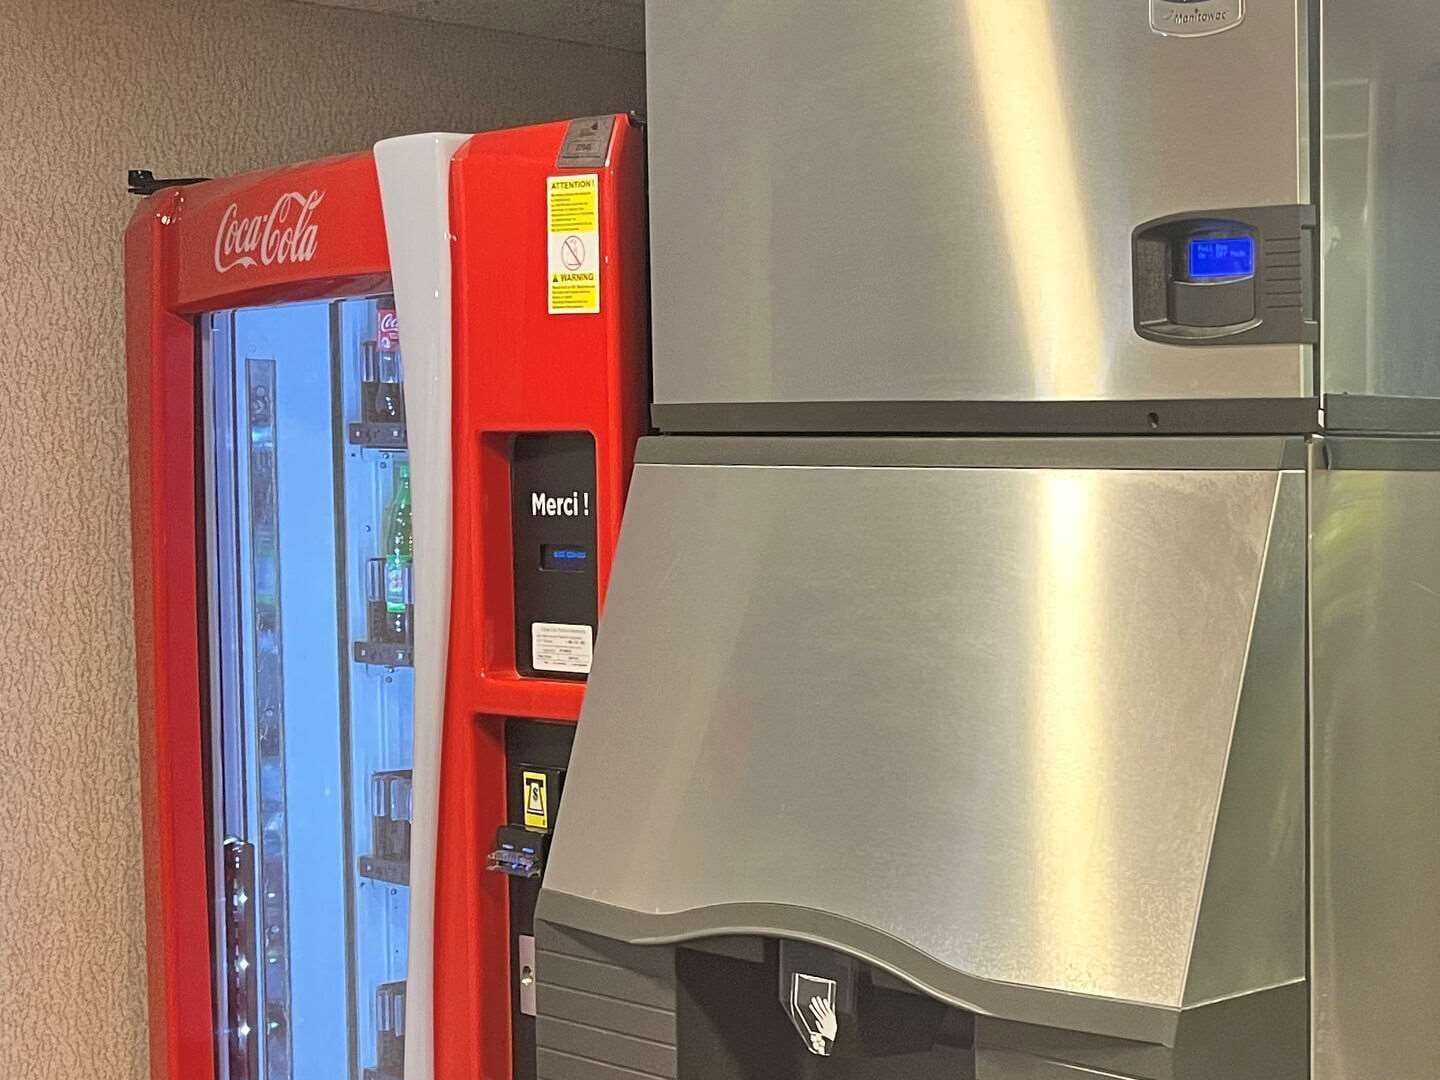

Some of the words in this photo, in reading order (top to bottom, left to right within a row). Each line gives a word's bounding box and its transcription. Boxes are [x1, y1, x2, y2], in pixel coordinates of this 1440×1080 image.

[1174, 9, 1226, 24] Manitowoc
[551, 182, 592, 190] ATTENTION
[214, 189, 326, 273] Coca-Cola
[561, 273, 594, 282] WARNING
[532, 492, 578, 517] Merci
